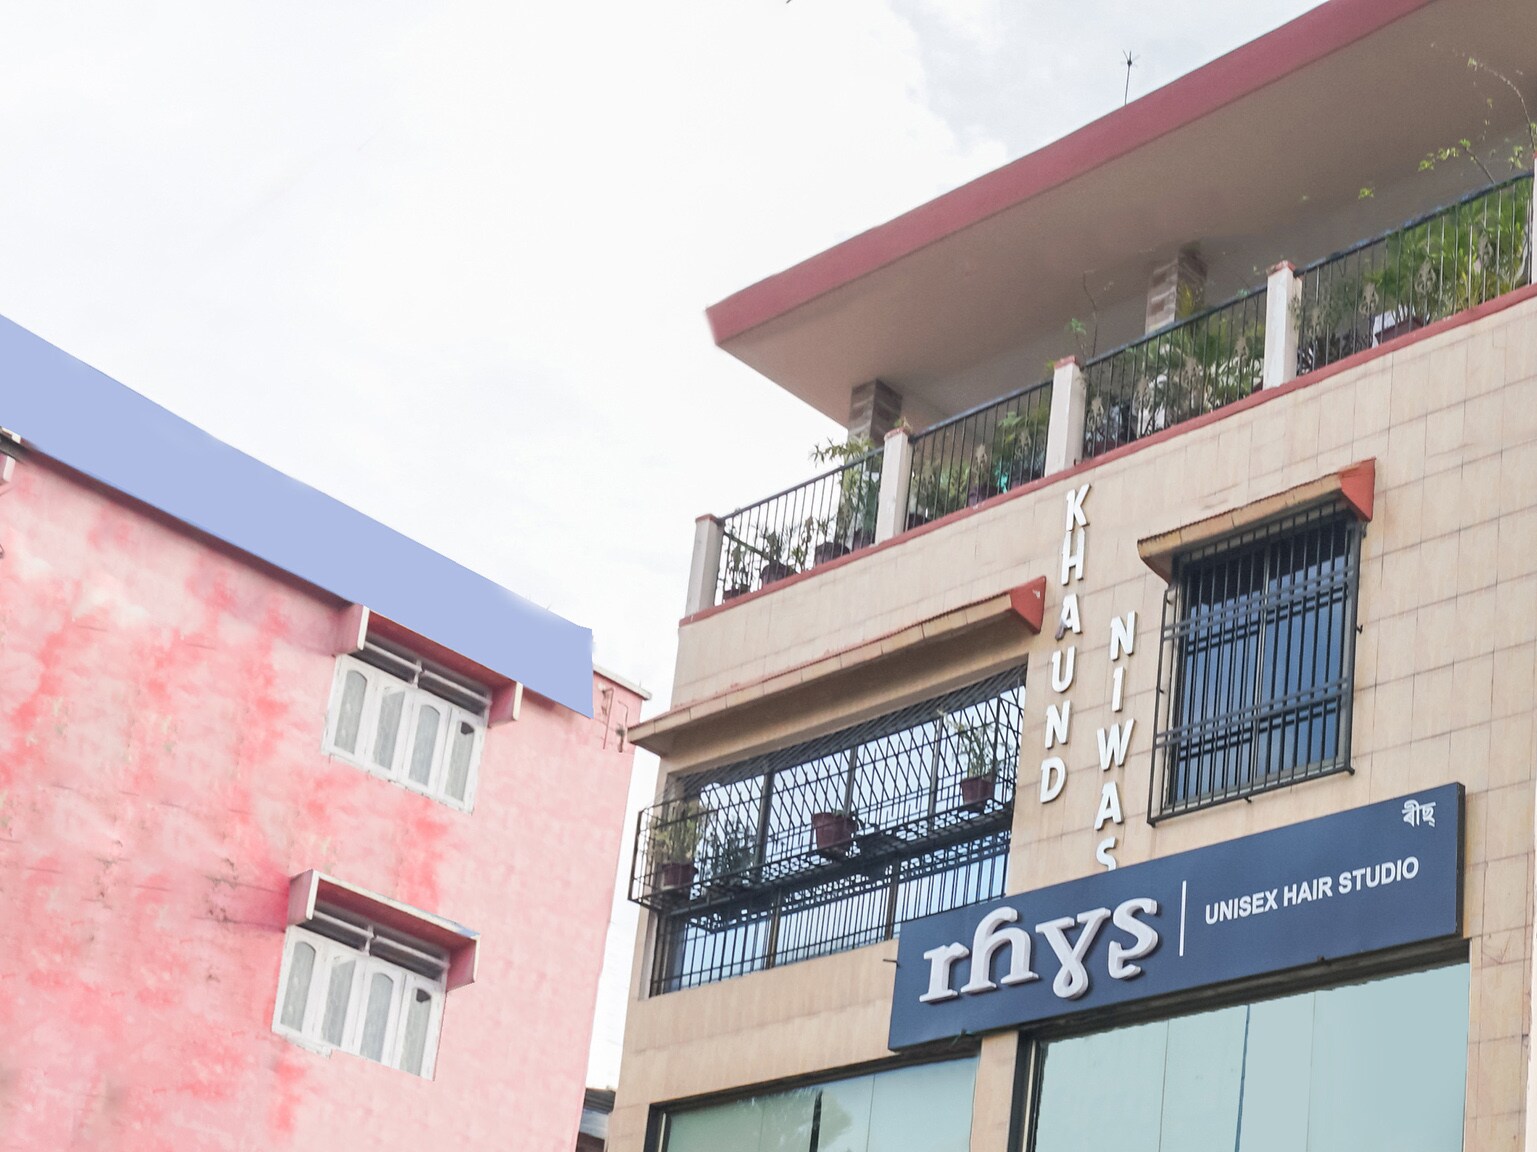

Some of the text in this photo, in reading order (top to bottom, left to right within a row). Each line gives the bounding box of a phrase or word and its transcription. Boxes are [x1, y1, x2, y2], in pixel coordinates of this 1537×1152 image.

[1039, 483, 1092, 804] KHAUND
[1094, 610, 1138, 871] NIWAS
[1205, 856, 1420, 925] UNISEX HAIR STUDIO
